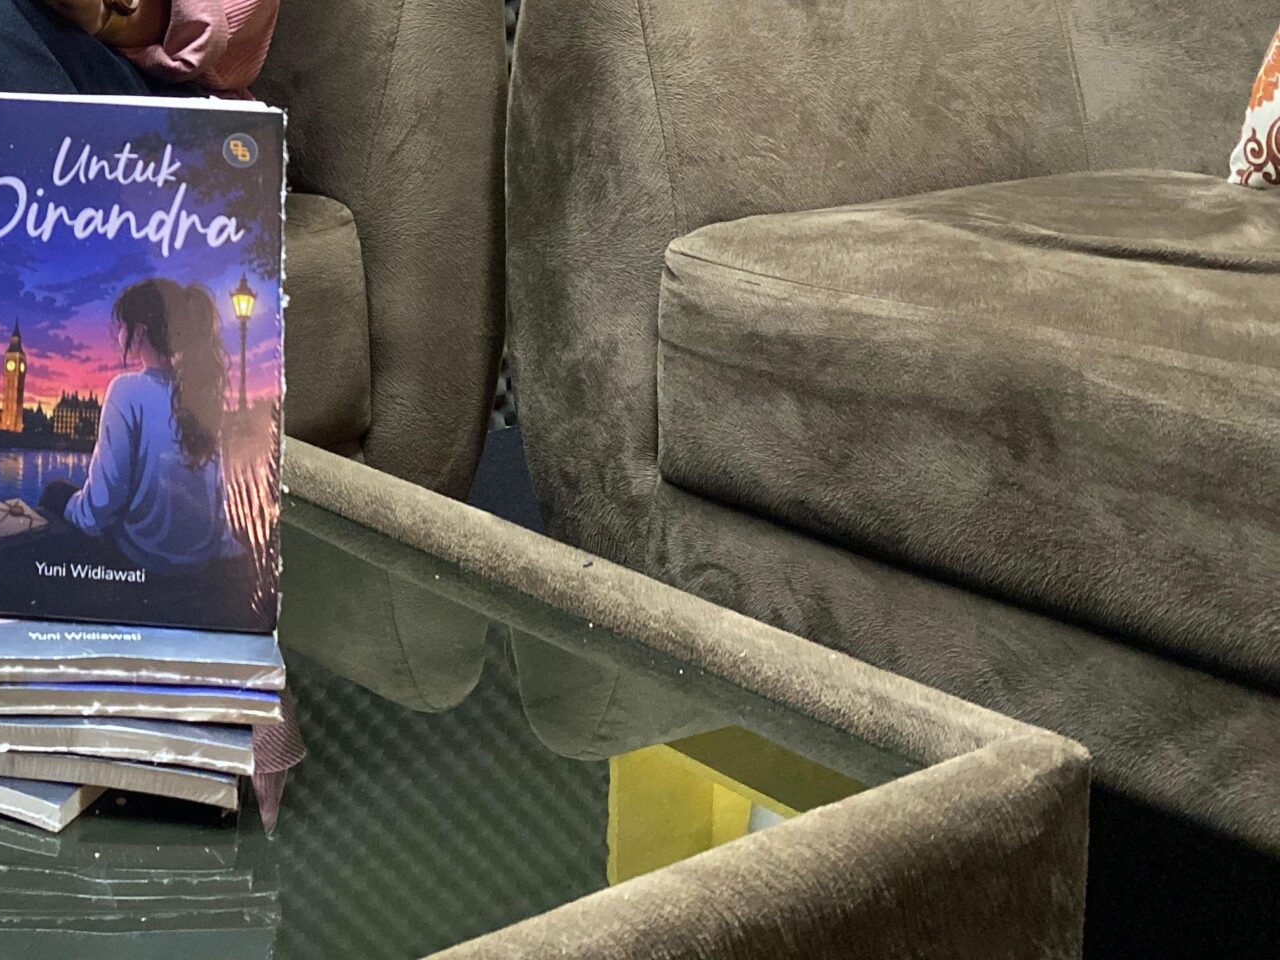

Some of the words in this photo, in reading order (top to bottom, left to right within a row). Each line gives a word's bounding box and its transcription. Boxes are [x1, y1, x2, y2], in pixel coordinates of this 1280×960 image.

[52, 137, 181, 187] Untuk
[36, 561, 66, 577] Yuni
[71, 563, 146, 583] Widiawati
[28, 632, 61, 641] Yuni
[64, 632, 141, 641] Widiawati
